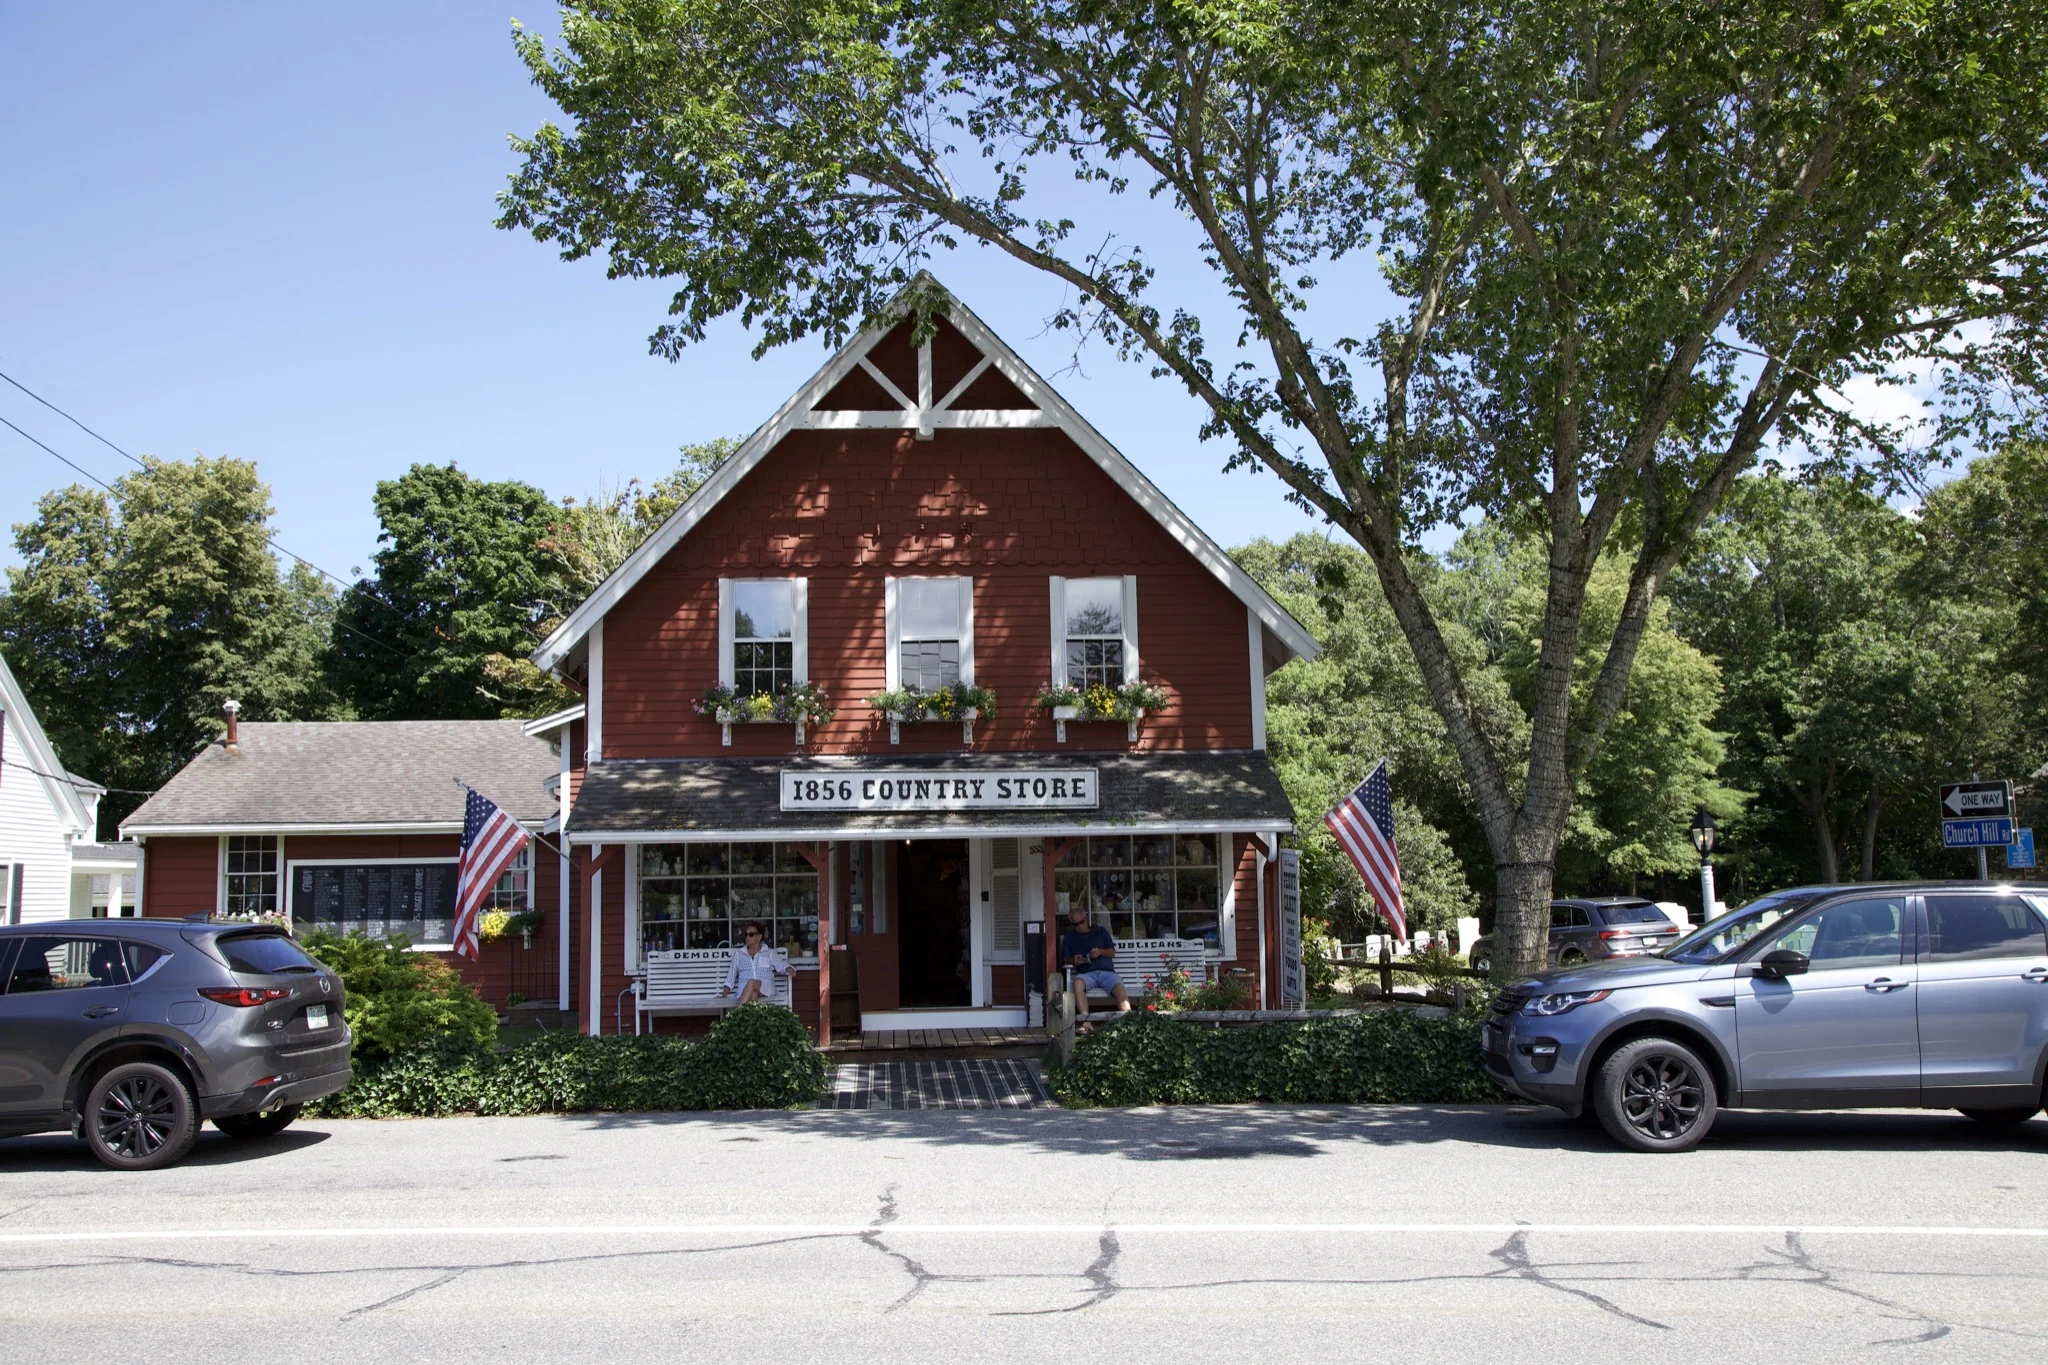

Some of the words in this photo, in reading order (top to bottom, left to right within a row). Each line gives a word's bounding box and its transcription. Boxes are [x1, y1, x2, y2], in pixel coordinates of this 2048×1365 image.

[793, 779, 852, 800] 1856
[862, 778, 985, 800] COUNTRY
[997, 777, 1086, 799] STORE
[1961, 795, 1979, 806] ONE
[1982, 794, 2000, 805] WAY
[1945, 824, 1979, 844] Church
[1982, 822, 1999, 842] Hill
[2002, 829, 2011, 841] Rd
[1115, 941, 1182, 949] UBLICANS
